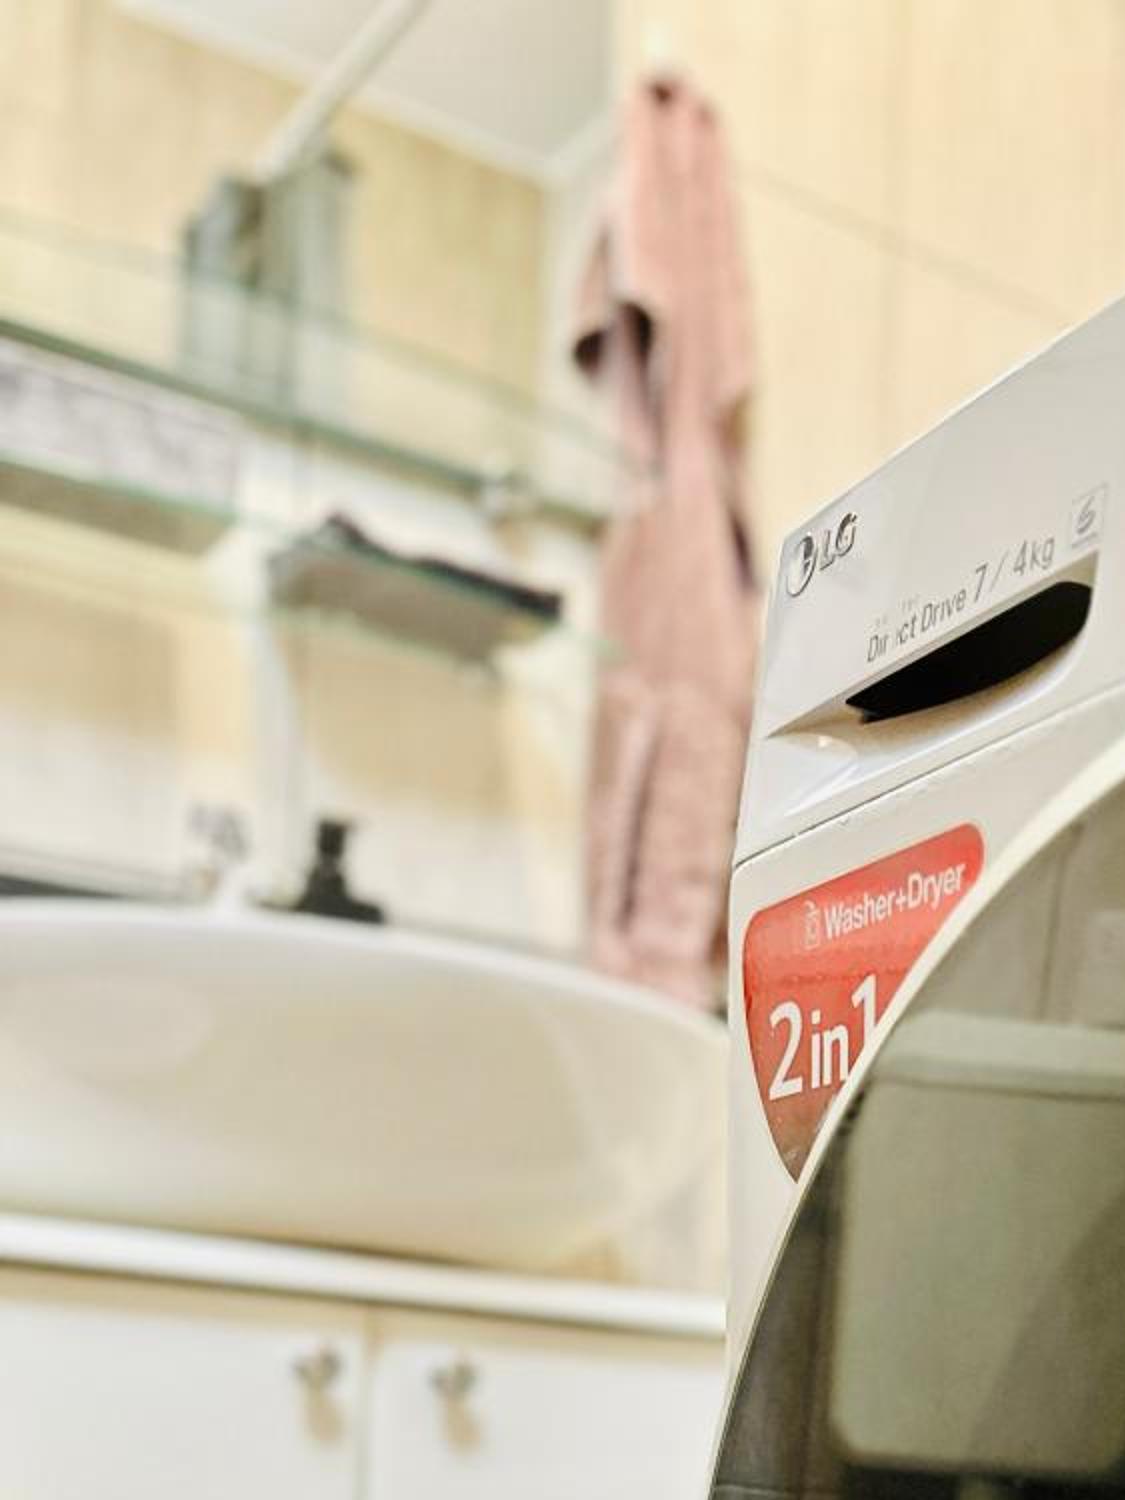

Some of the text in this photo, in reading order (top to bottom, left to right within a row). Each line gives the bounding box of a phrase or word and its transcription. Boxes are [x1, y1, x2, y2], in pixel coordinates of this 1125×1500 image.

[819, 512, 858, 572] LG
[867, 612, 918, 662] Dirct
[921, 588, 967, 632] Drive
[974, 560, 989, 603] 7
[1013, 536, 1056, 576] 4kg
[823, 862, 967, 940] Washer+Dryer
